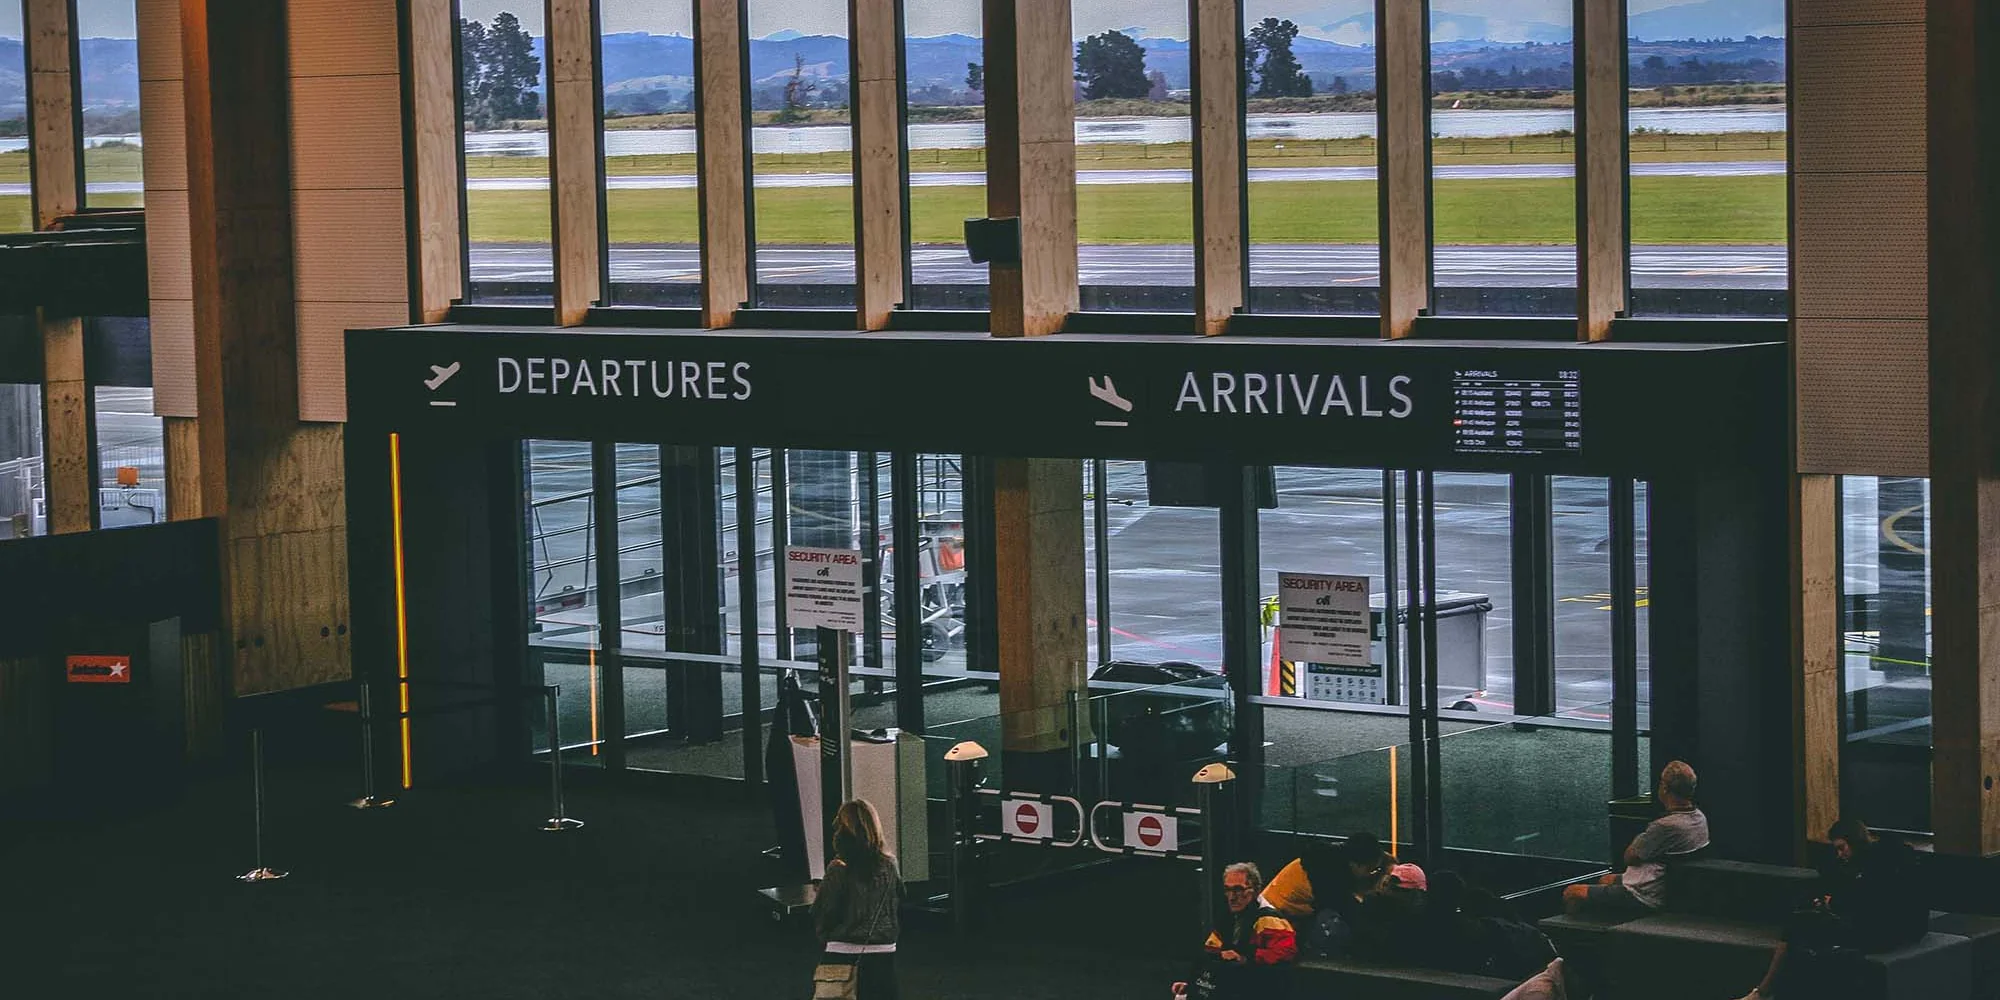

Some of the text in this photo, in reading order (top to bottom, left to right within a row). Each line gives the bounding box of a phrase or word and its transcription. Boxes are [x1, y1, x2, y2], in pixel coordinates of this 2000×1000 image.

[498, 357, 752, 400] DEPARTURES
[1175, 371, 1412, 418] ARRIVALS
[789, 551, 857, 565] SECURITY AREA
[1283, 577, 1364, 593] SECURITY AREA
